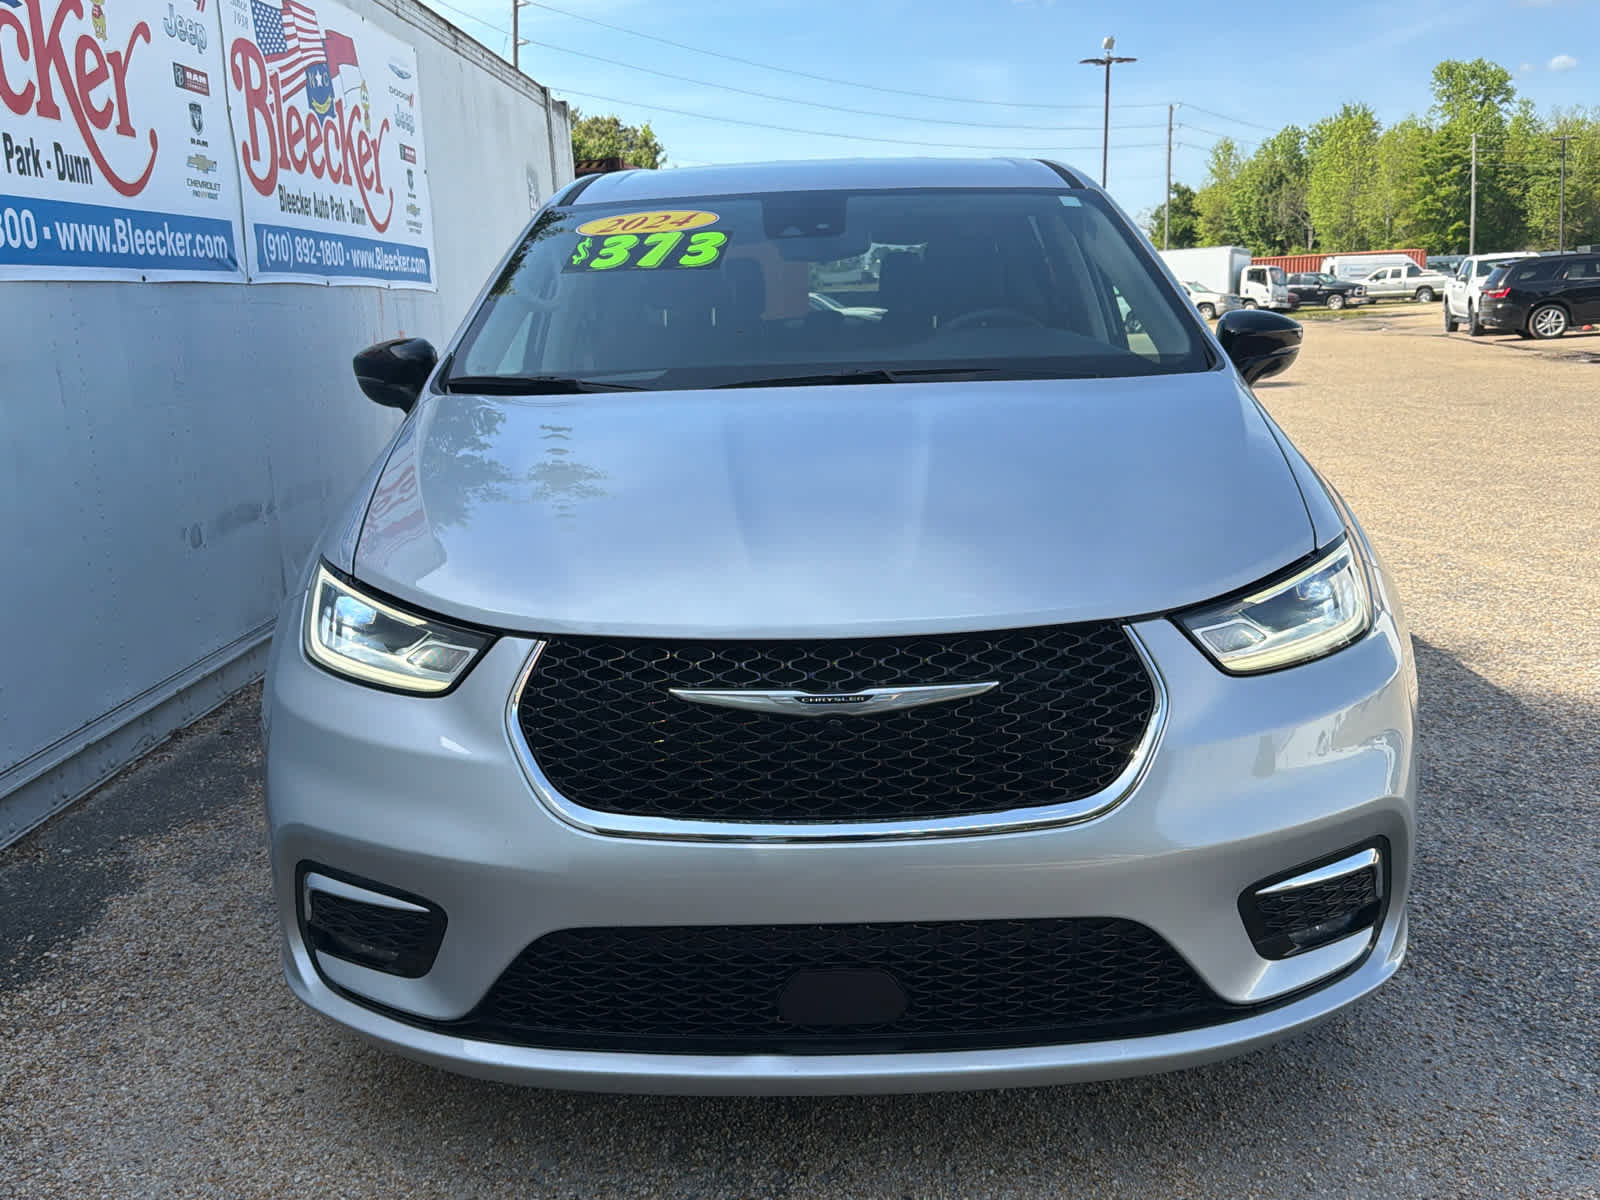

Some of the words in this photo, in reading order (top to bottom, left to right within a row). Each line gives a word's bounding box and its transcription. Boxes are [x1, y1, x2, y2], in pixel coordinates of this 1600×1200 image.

[163, 3, 207, 54] Jeep
[231, 38, 393, 233] Bleecker
[2, 131, 43, 178] Park
[53, 141, 93, 185] Dunn
[186, 178, 220, 192] CHEVROLET
[278, 183, 312, 216] Bleecker
[313, 192, 330, 220] Auto
[330, 195, 347, 223] Park
[350, 199, 366, 225] Dunn
[55, 217, 228, 259] www.Bleecker.com
[597, 212, 700, 233] 2024
[263, 229, 294, 269] (910)
[295, 236, 345, 266] 892-1800
[351, 247, 427, 275] www.Bleecker.com
[572, 231, 728, 269] $373
[801, 695, 865, 703] CHRYSLER
